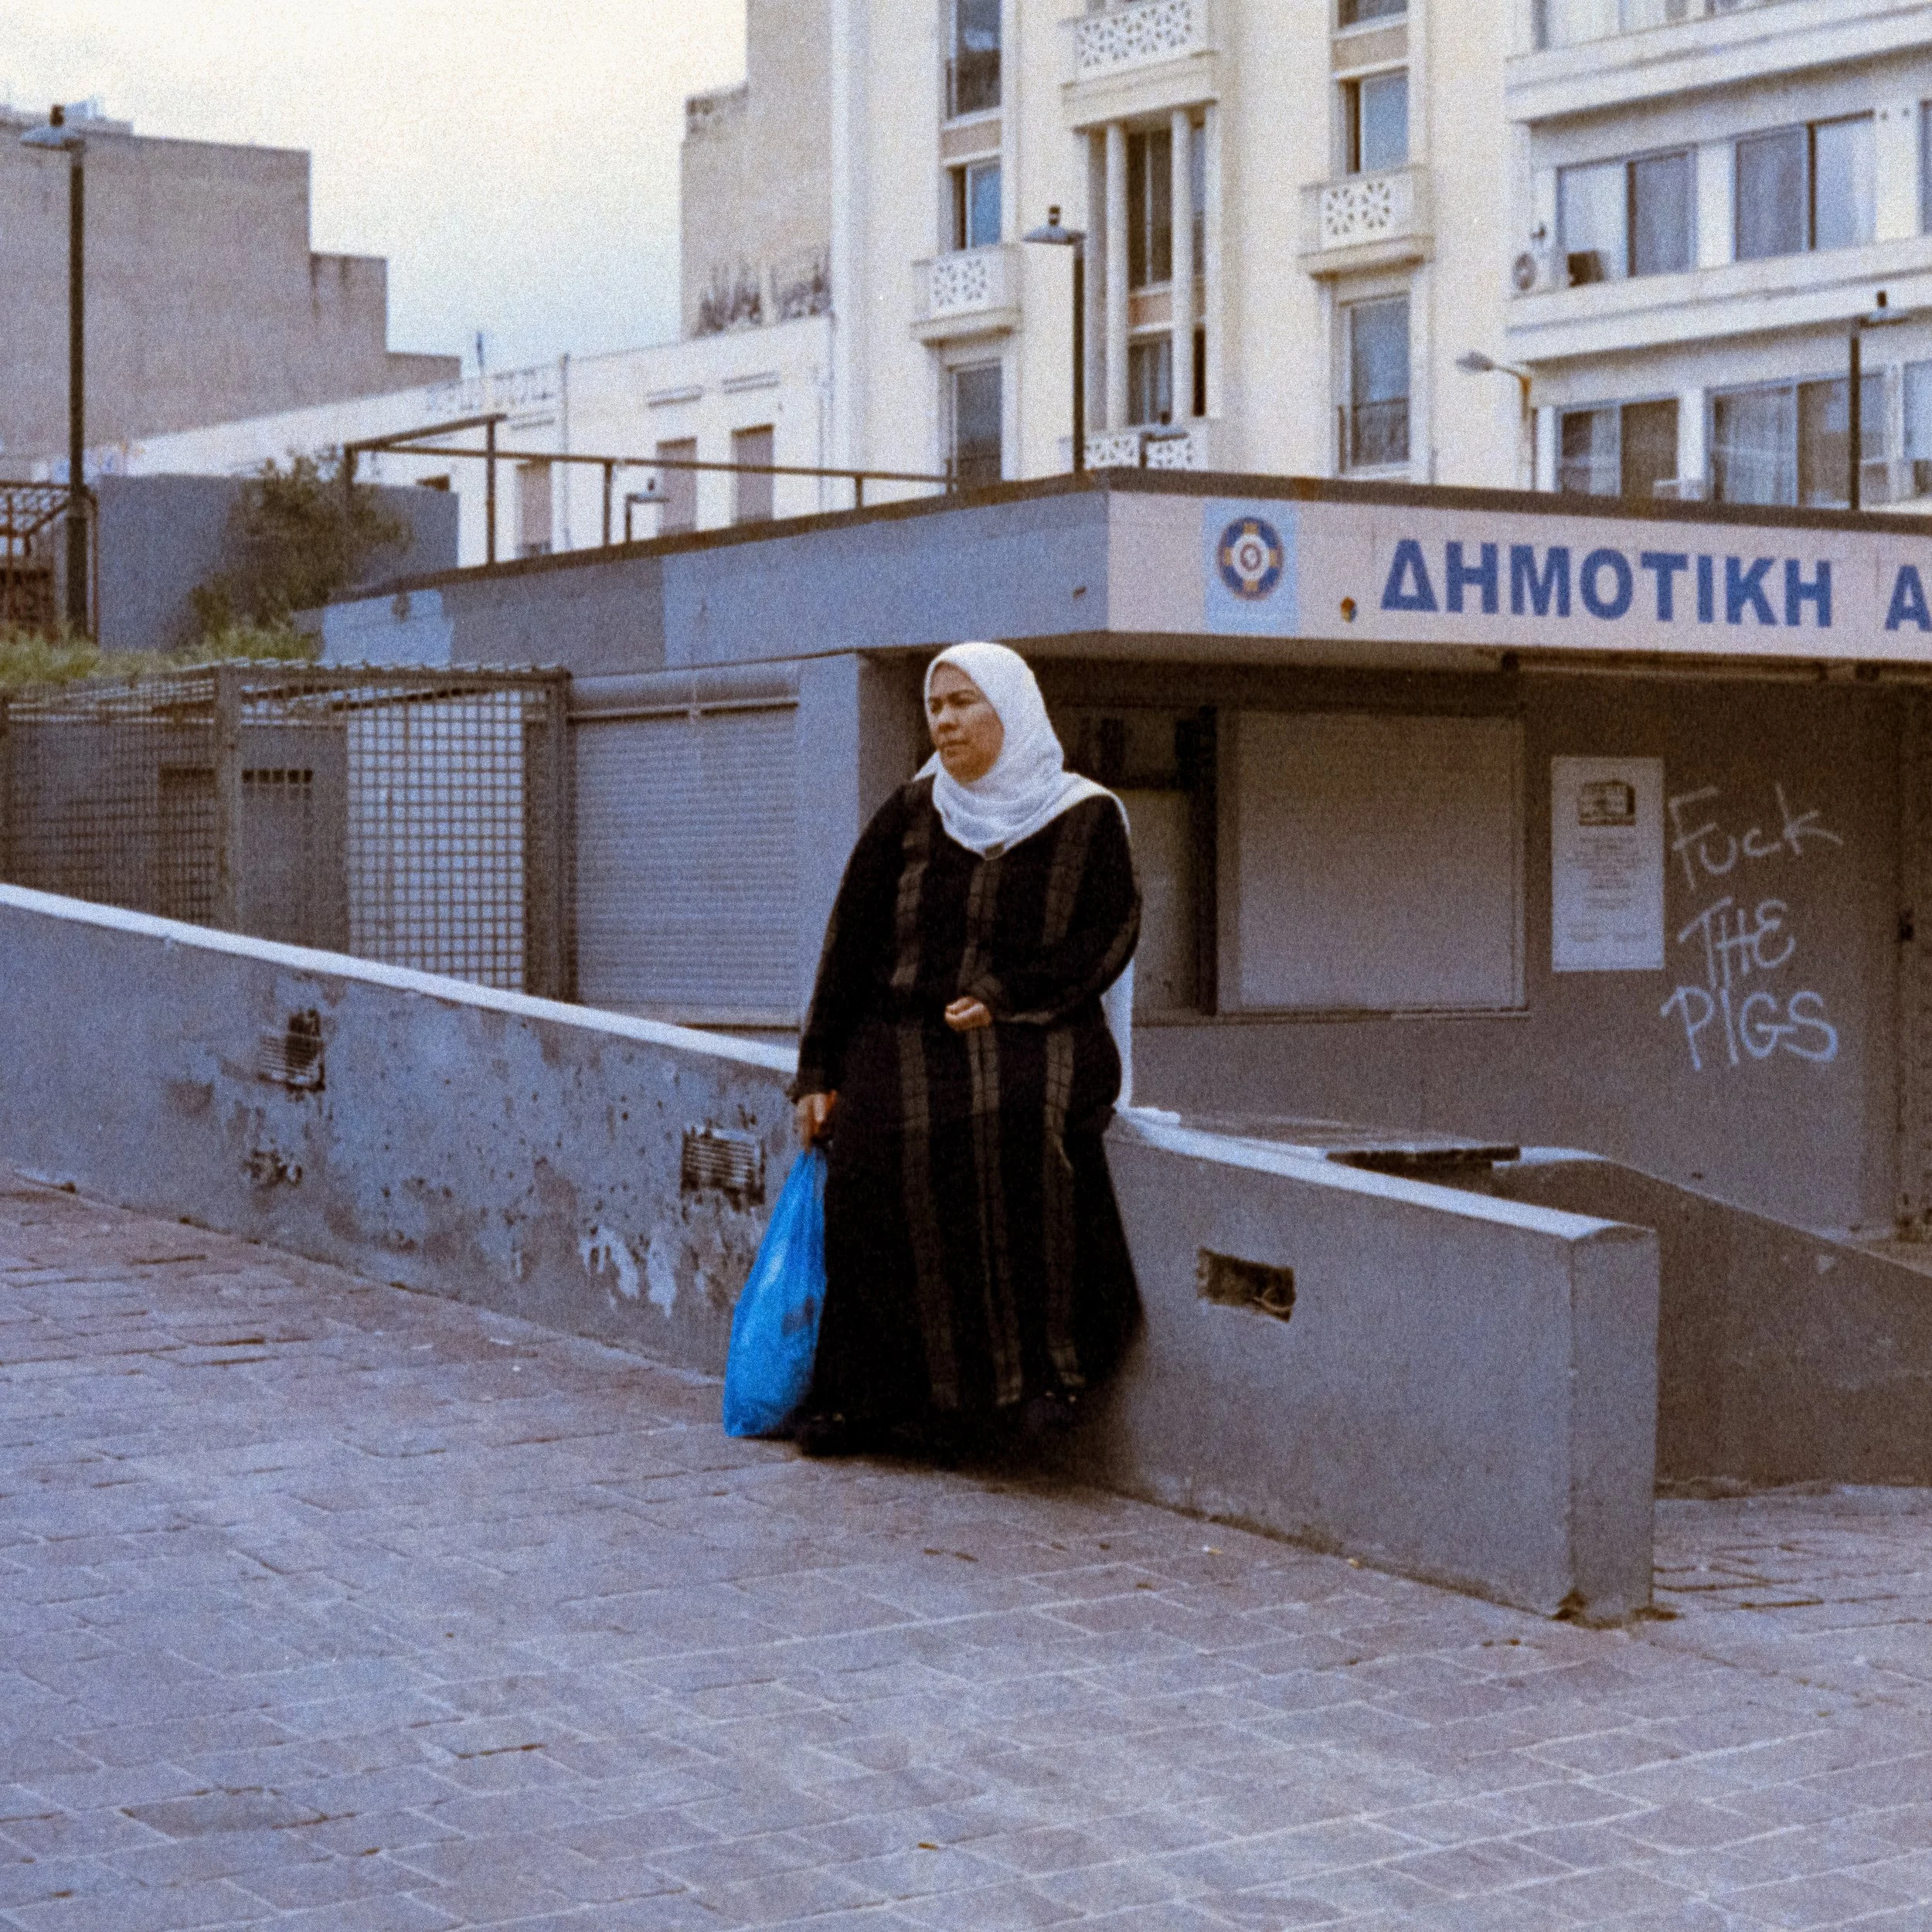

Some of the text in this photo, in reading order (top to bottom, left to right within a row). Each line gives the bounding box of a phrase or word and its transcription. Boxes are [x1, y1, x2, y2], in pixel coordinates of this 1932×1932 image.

[1380, 539, 1832, 628] ΔΗΜΟΤΙΚΗ
[1679, 896, 1797, 991] THE
[1659, 985, 1839, 1071] PIGS
